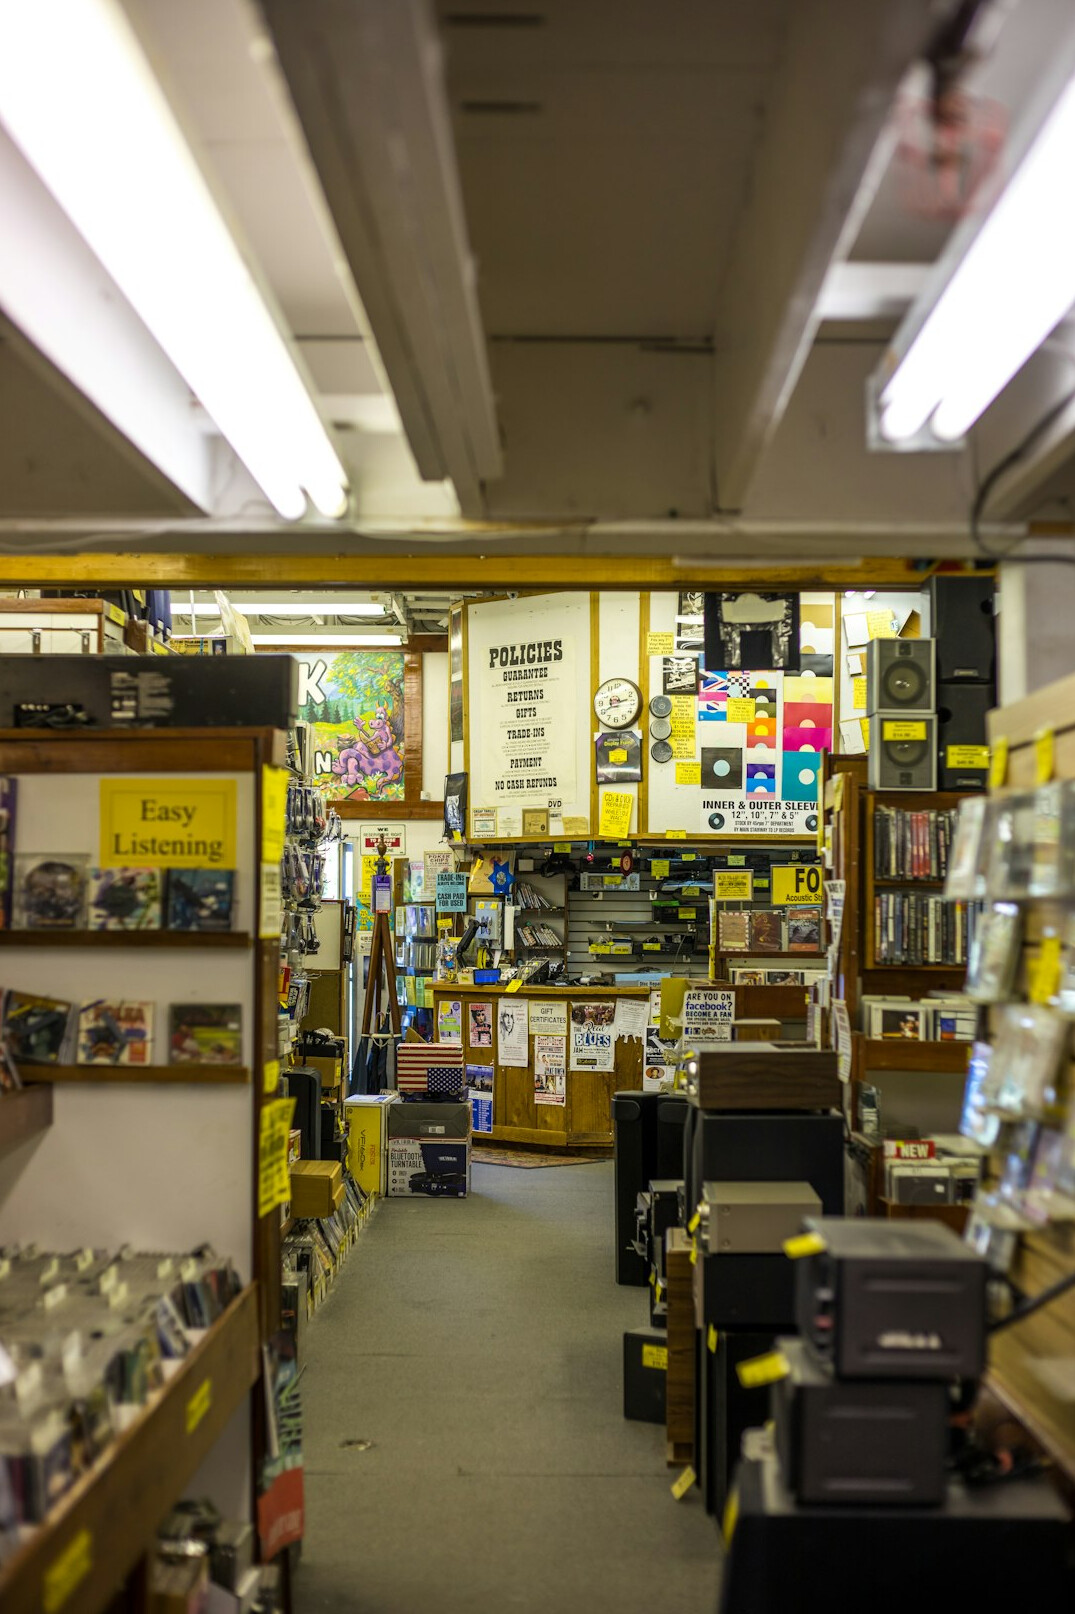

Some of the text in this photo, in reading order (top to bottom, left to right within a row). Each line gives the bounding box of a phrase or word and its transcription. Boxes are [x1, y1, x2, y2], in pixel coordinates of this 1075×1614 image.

[490, 640, 562, 668] POLICIES
[503, 667, 548, 682] GUARANTEE
[298, 659, 327, 707] K
[507, 689, 544, 702] RETURNS
[516, 707, 537, 718] GIFTS
[507, 728, 545, 740] TRADE-INS
[315, 751, 332, 775] N
[510, 757, 542, 768] PAYMENT
[495, 778, 557, 790] NO CASH REFUNDS
[703, 801, 734, 809] INNER
[749, 801, 781, 810] OUTER
[141, 799, 197, 828] Easy
[114, 832, 224, 862] Listening
[686, 1002, 732, 1010] facebook?
[583, 1020, 606, 1034] Real
[575, 1033, 610, 1047] BLUES
[901, 1144, 929, 1158] NEW
